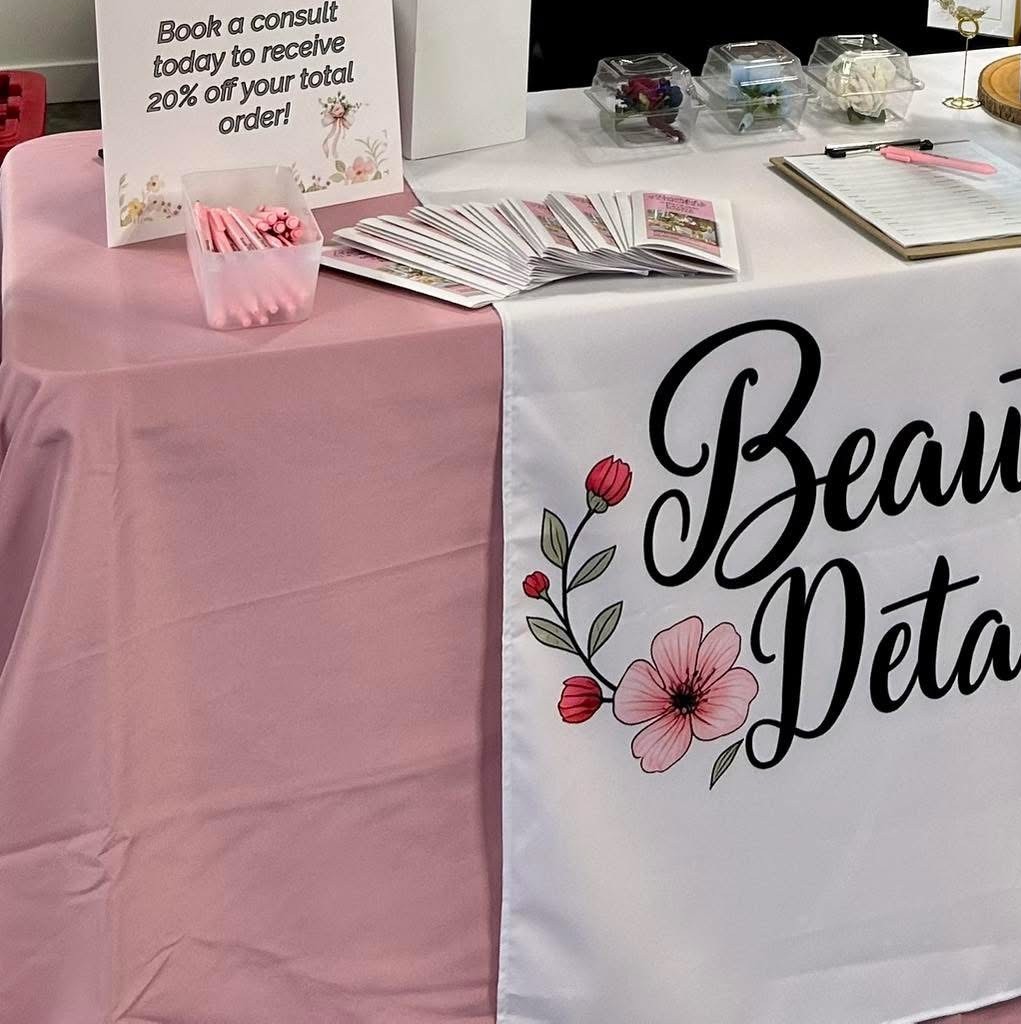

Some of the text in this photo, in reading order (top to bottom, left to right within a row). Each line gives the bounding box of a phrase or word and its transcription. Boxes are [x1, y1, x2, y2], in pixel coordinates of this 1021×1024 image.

[158, 1, 338, 44] Book a consult
[154, 34, 345, 78] today to receive
[147, 61, 354, 112] 20% off your total
[219, 102, 290, 134] order!
